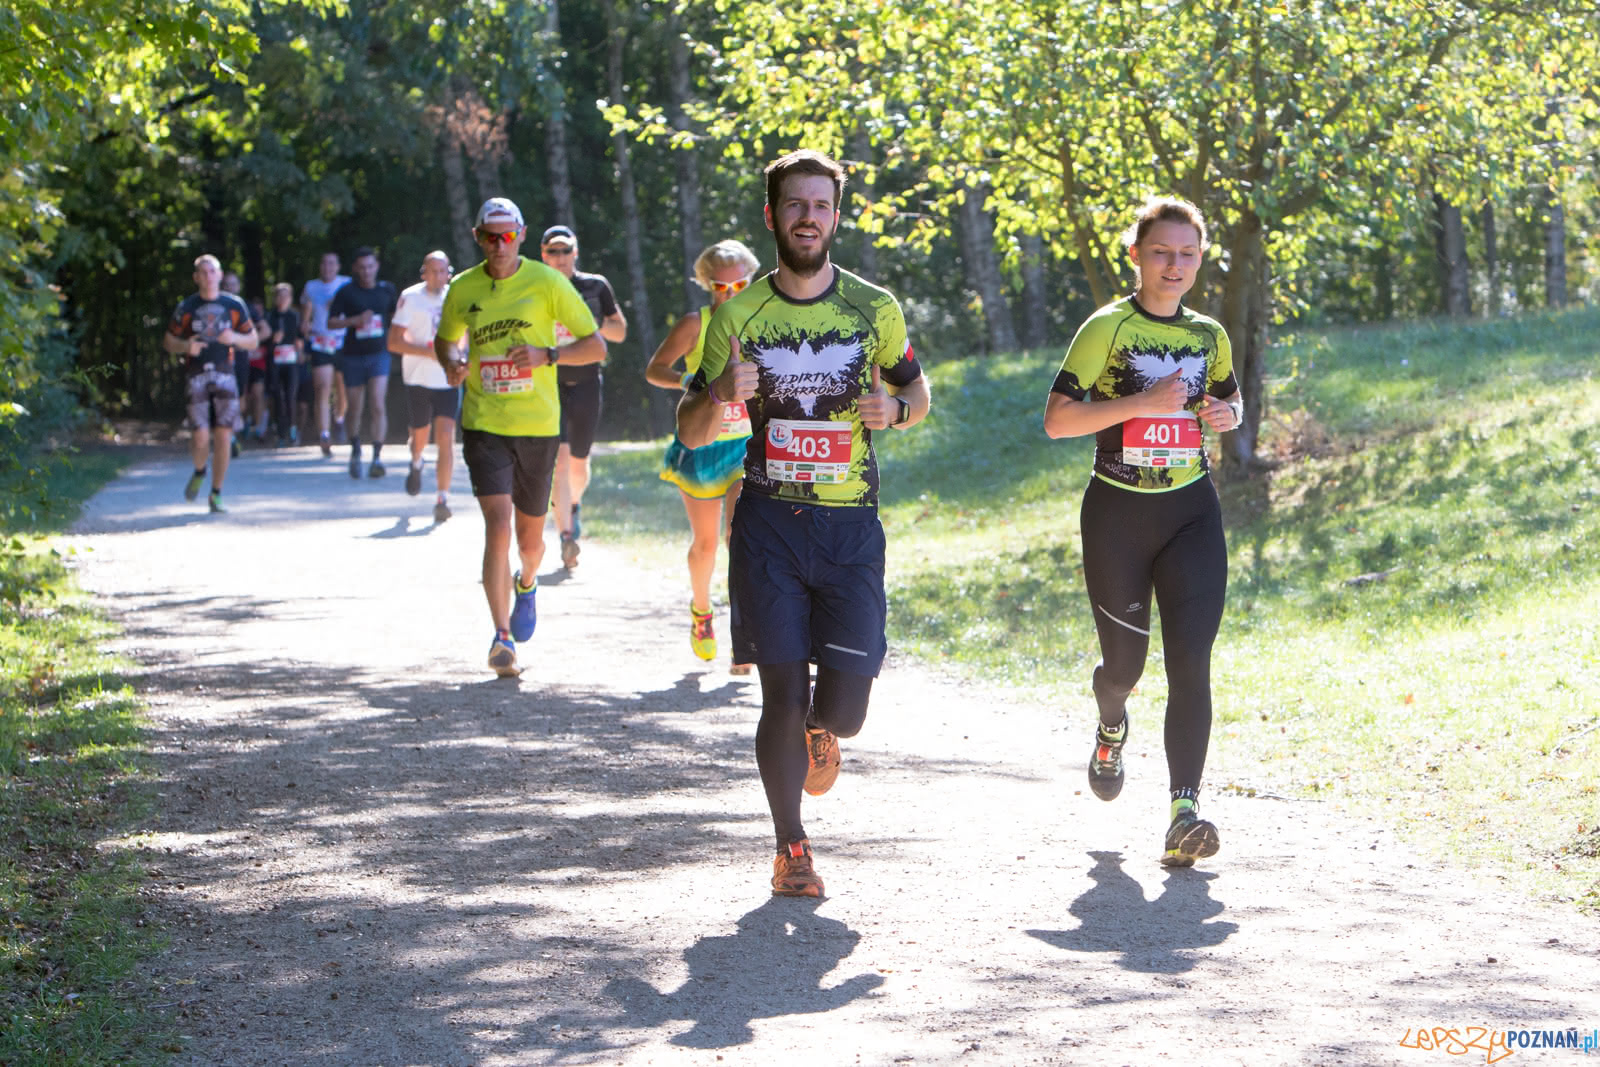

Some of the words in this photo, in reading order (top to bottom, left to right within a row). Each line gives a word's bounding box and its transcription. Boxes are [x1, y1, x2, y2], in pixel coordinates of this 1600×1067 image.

[494, 364, 519, 378] 186
[787, 372, 831, 384] DIRTY
[770, 383, 848, 401] SPARROWS
[1143, 424, 1180, 444] 401
[787, 436, 831, 458] 403
